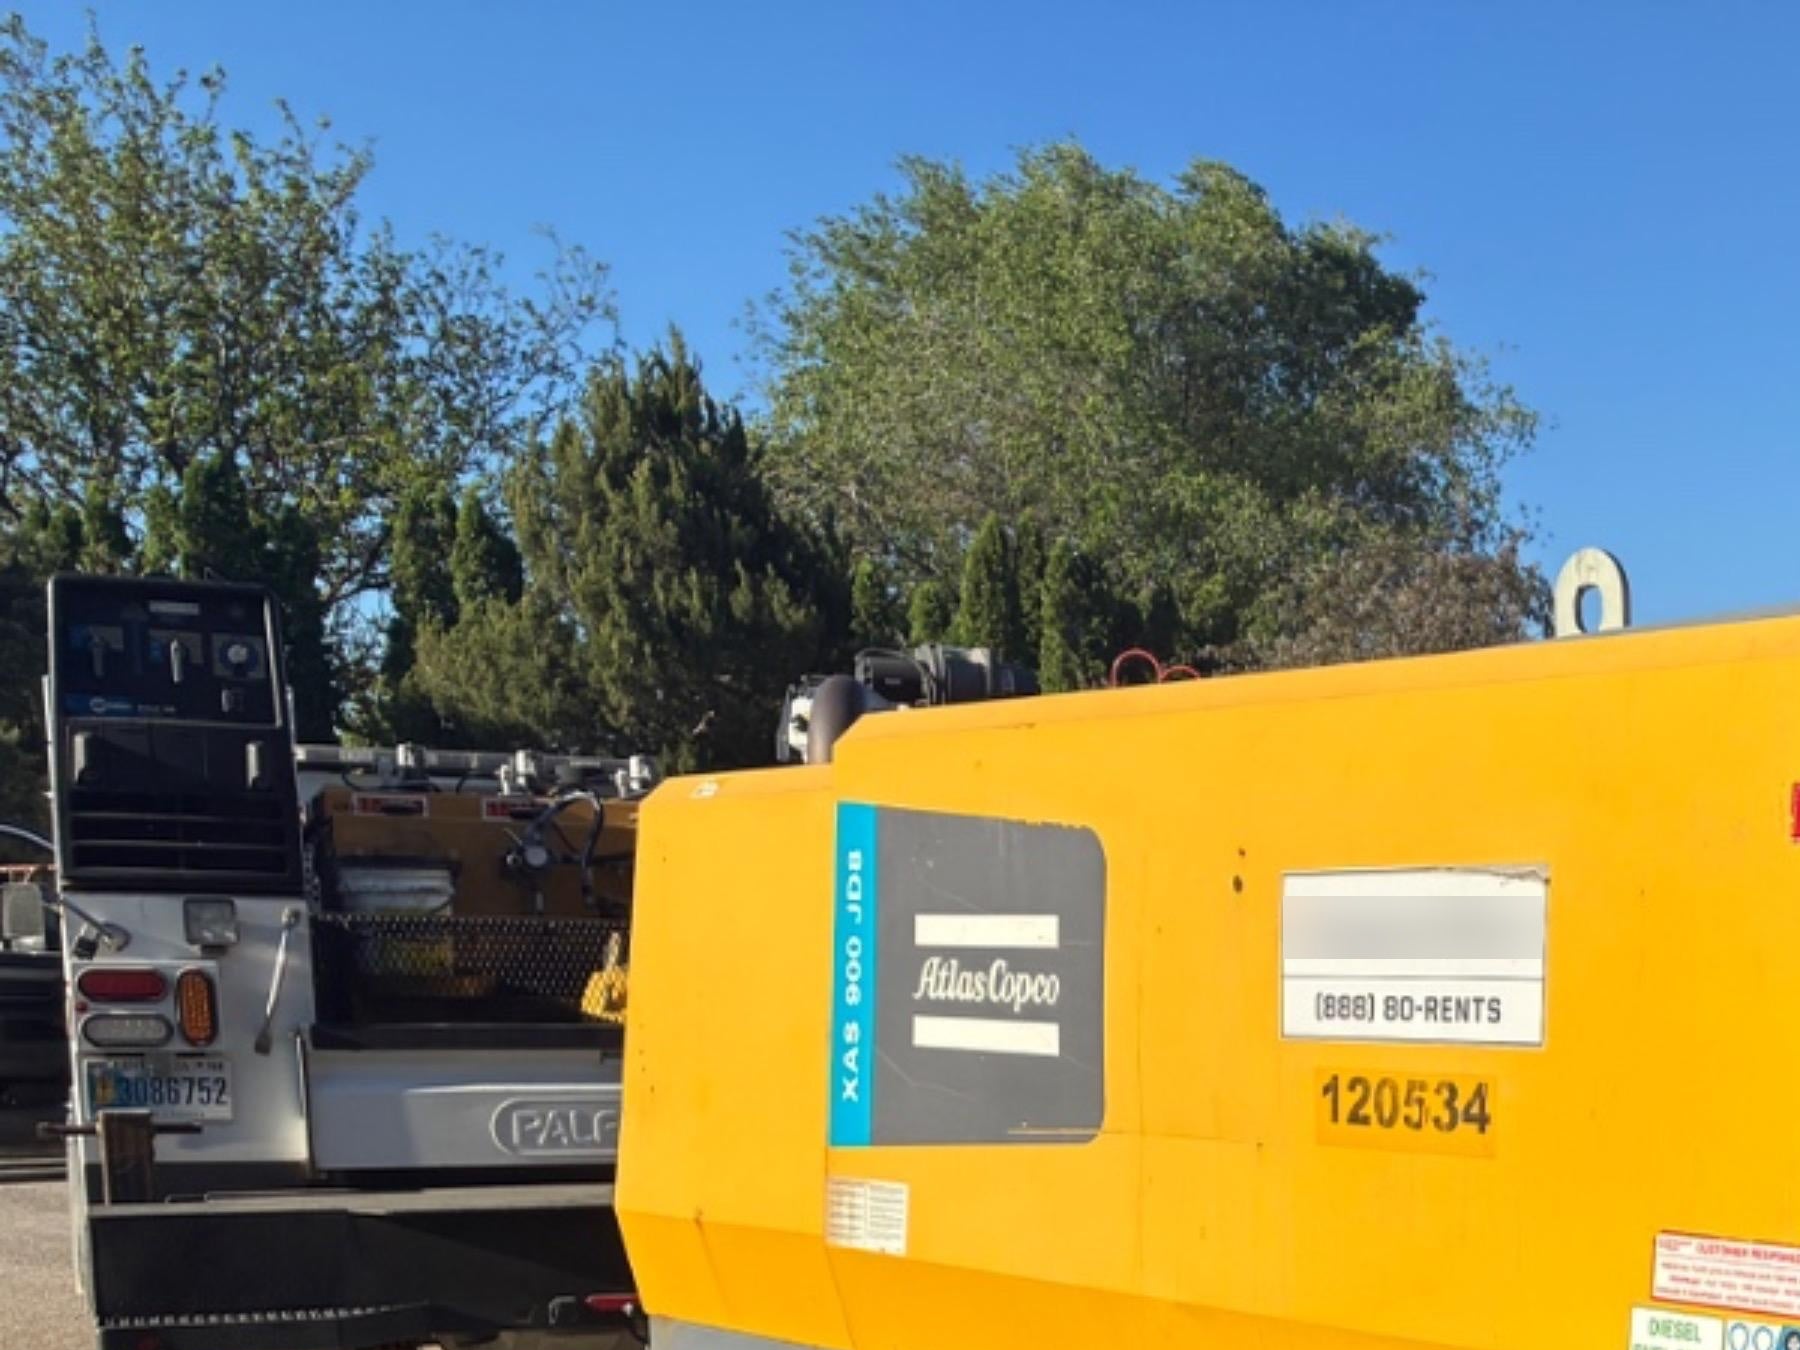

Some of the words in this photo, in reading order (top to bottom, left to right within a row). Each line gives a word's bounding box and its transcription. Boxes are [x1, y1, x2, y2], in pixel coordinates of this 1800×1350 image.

[844, 936, 863, 1006] 900
[1315, 991, 1375, 1022] (888)
[1382, 995, 1501, 1024] 80-RENTS
[842, 1021, 862, 1103] XAS
[1321, 1073, 1491, 1134] 120534
[1647, 1316, 1702, 1343] DIESEL
